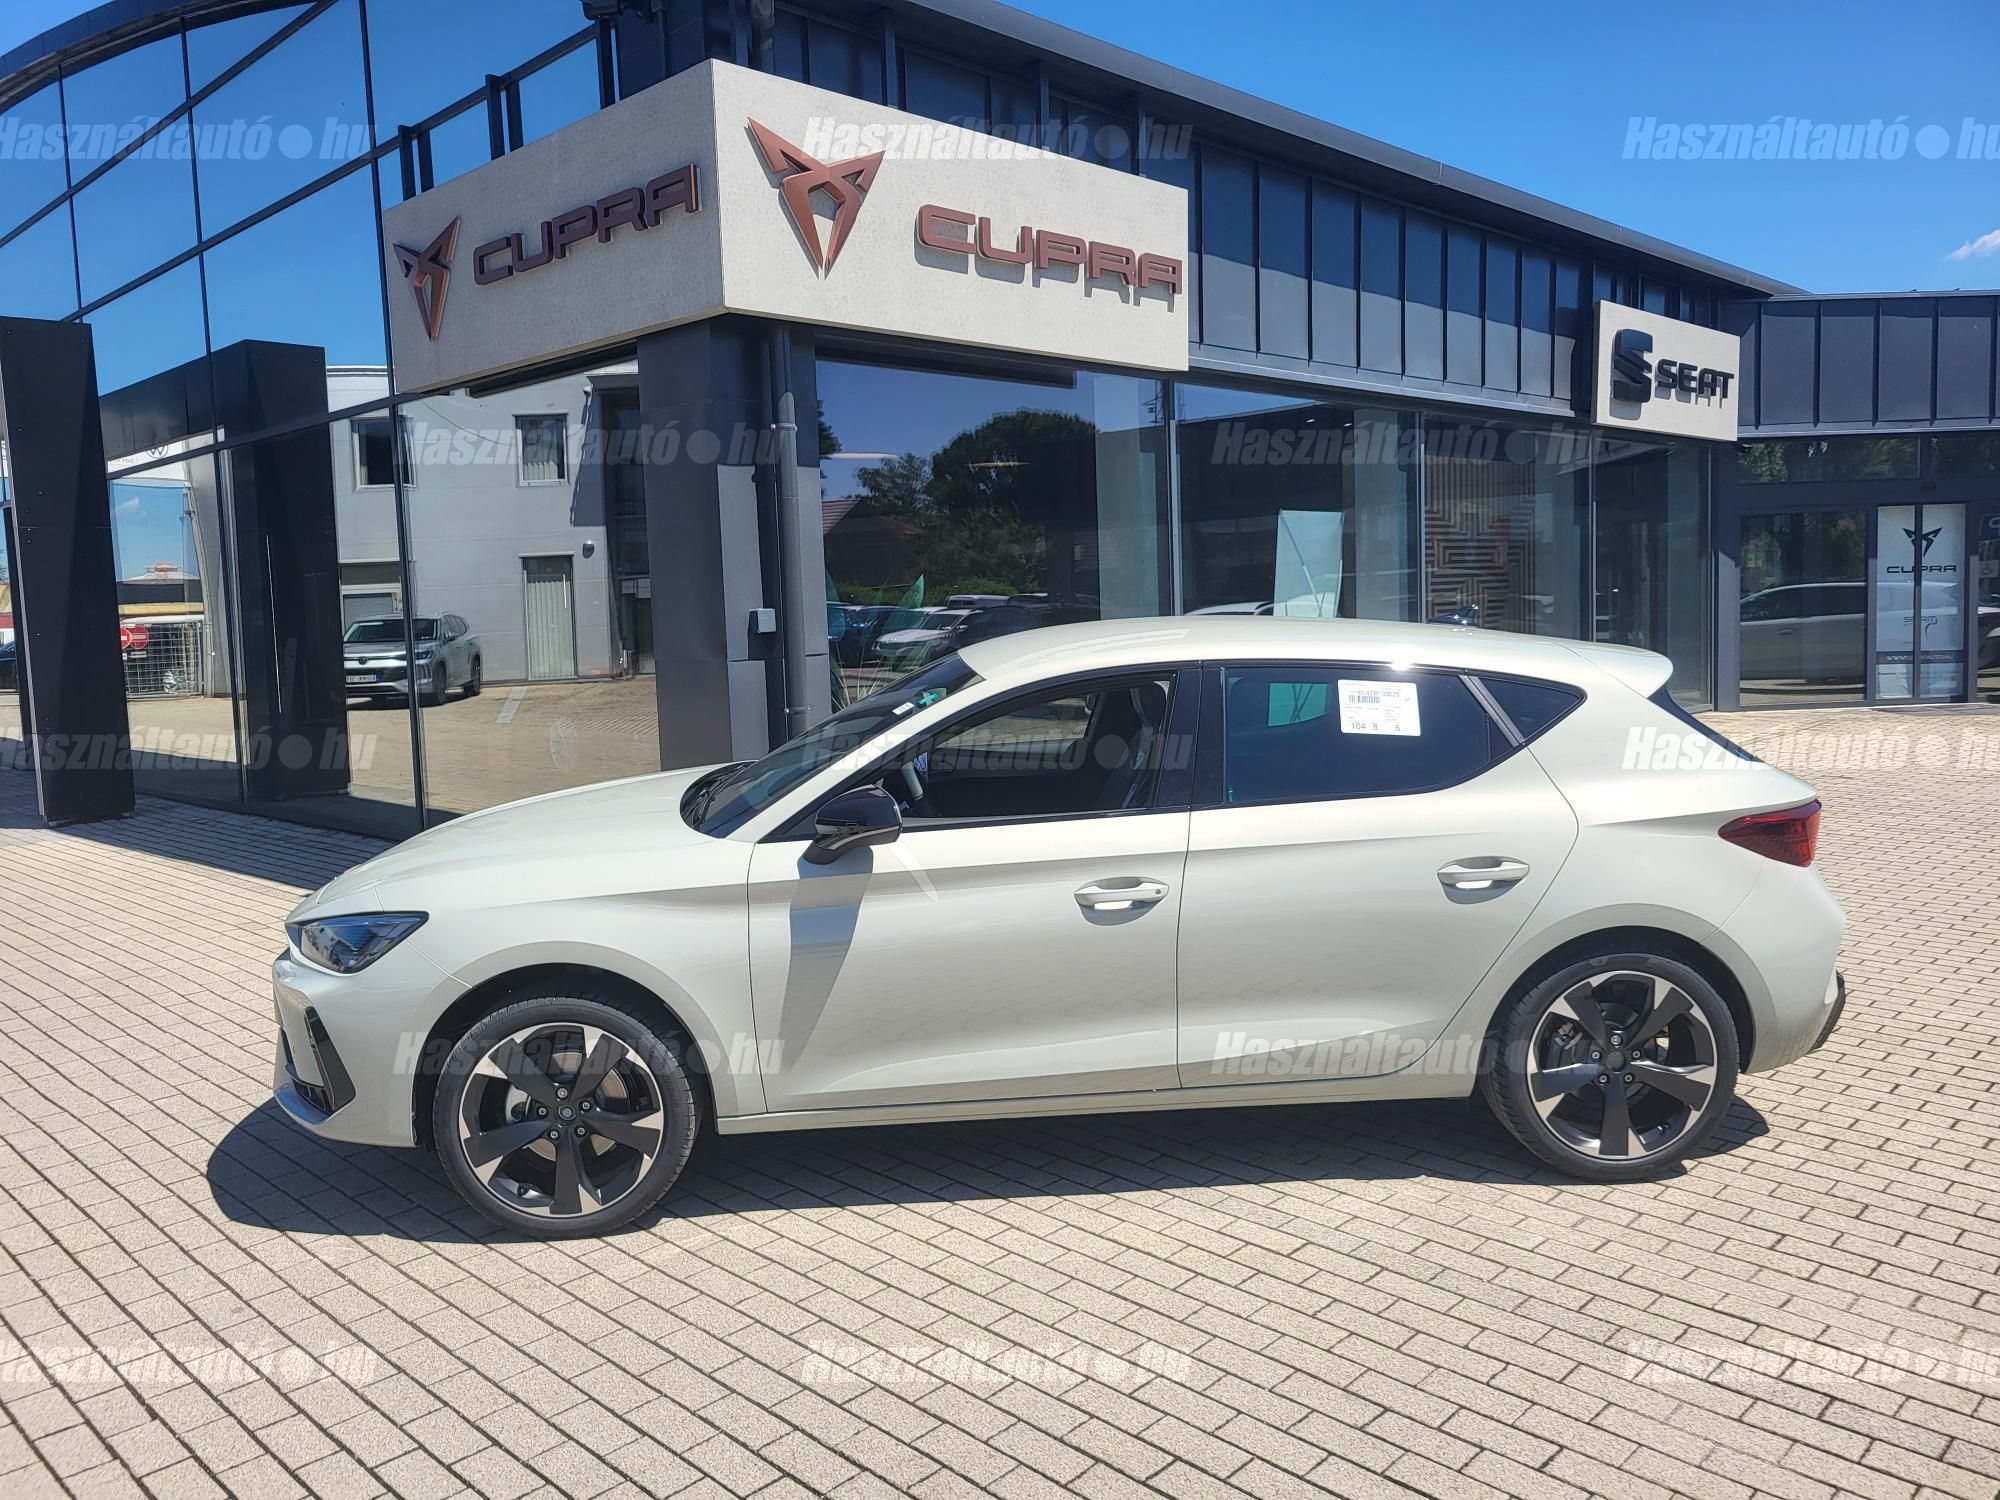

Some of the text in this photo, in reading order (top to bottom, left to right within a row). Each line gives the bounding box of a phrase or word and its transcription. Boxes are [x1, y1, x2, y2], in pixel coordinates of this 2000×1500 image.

[473, 164, 702, 285] CUPRA
[917, 204, 1183, 295] CUPRA
[1656, 358, 1735, 399] SEAT
